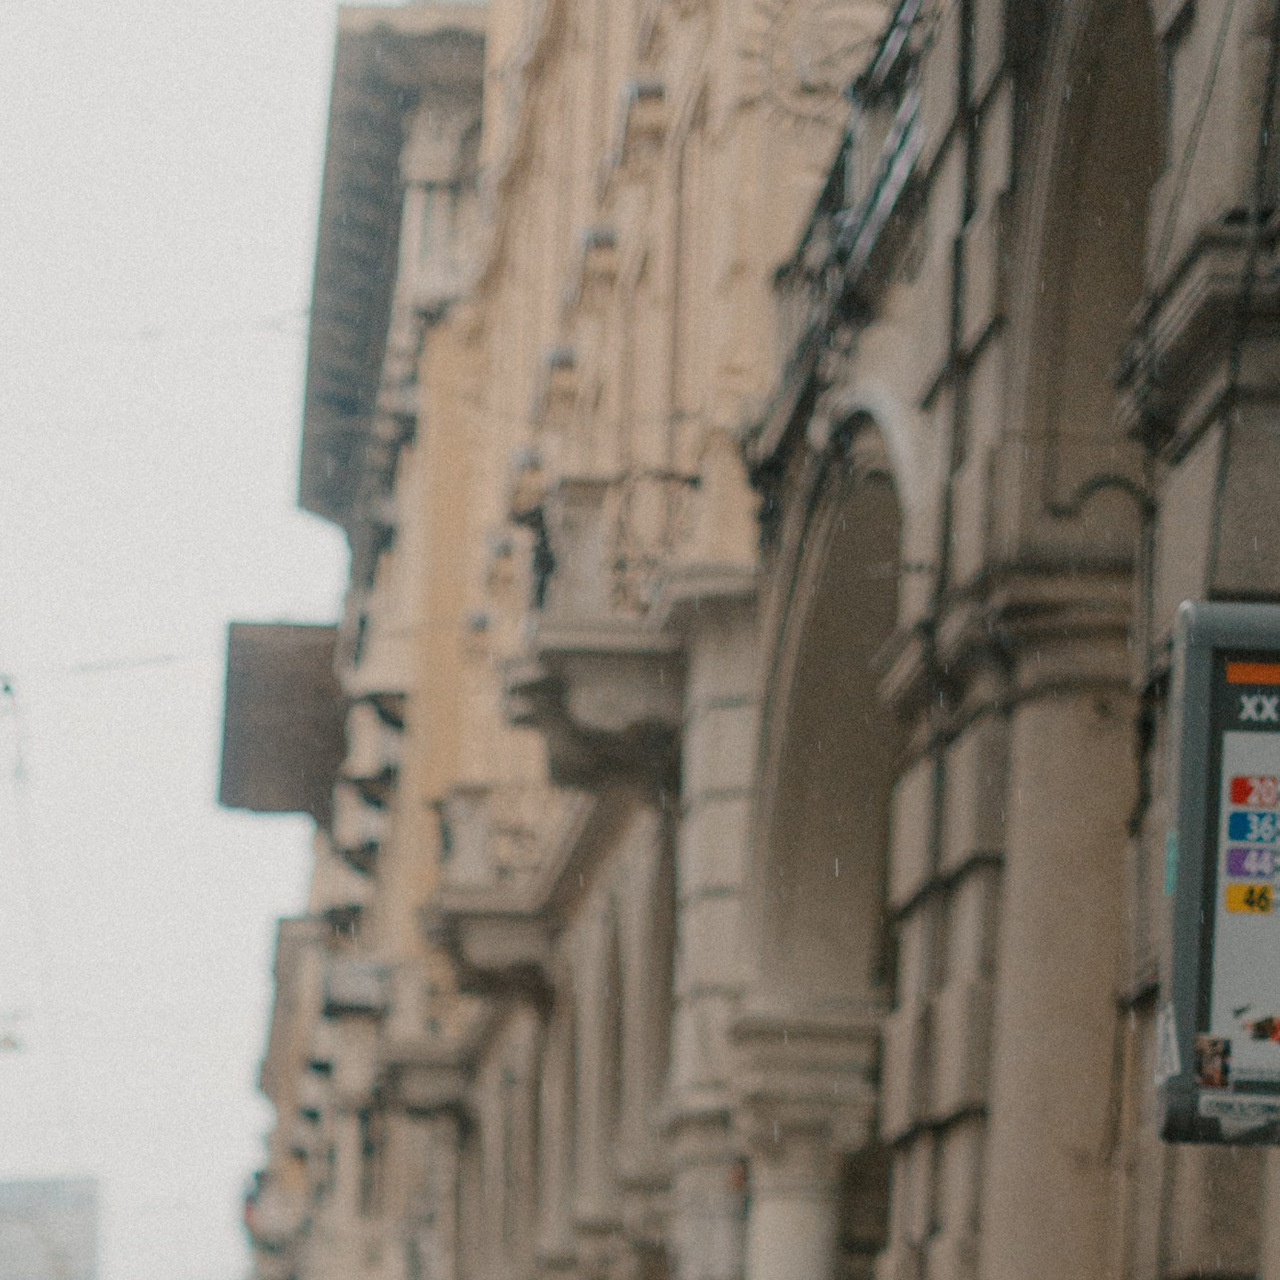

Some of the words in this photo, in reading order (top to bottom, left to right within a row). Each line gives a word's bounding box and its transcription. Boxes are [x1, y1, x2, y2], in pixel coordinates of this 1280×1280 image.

[1246, 814, 1273, 841] 36
[1243, 849, 1273, 874] 44
[1244, 885, 1271, 911] 46
